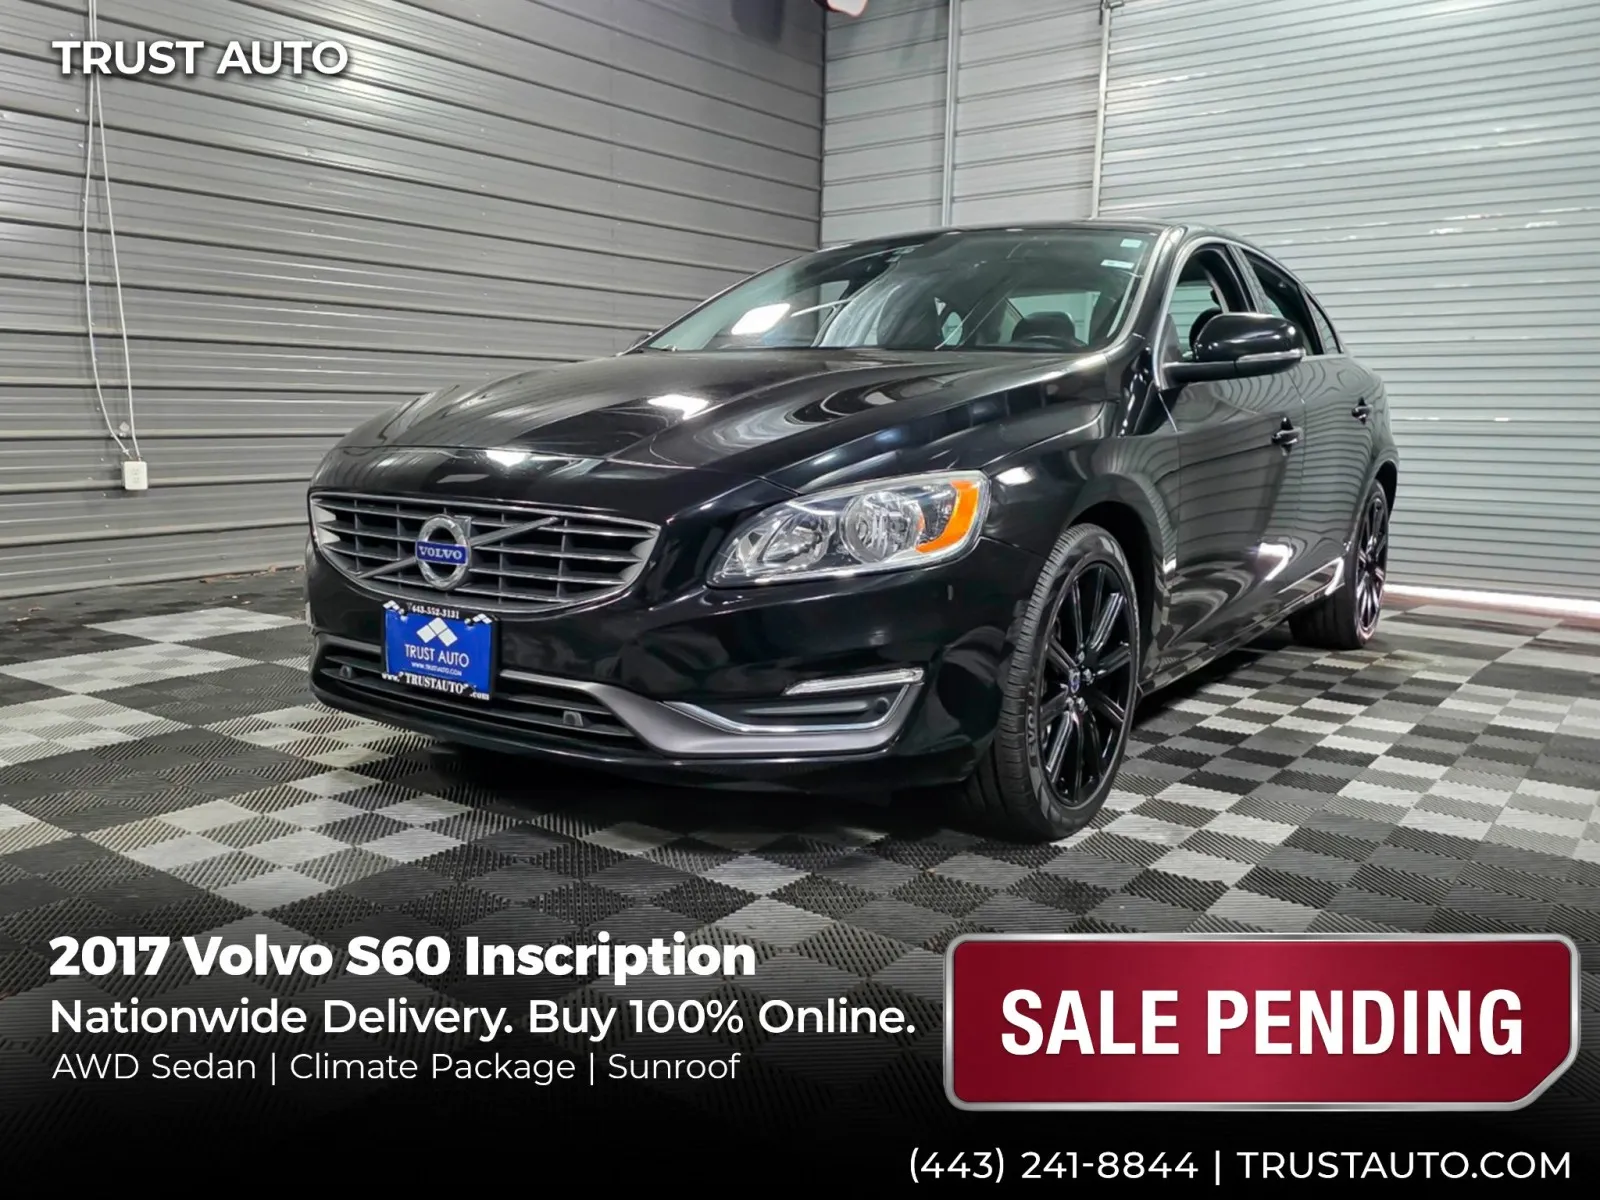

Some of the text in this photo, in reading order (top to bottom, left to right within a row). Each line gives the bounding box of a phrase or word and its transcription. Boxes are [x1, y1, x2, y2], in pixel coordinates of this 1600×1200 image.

[418, 545, 463, 560] VOLVO
[404, 643, 470, 668] TRUST AUTO
[404, 672, 466, 695] TRUSTAUTO
